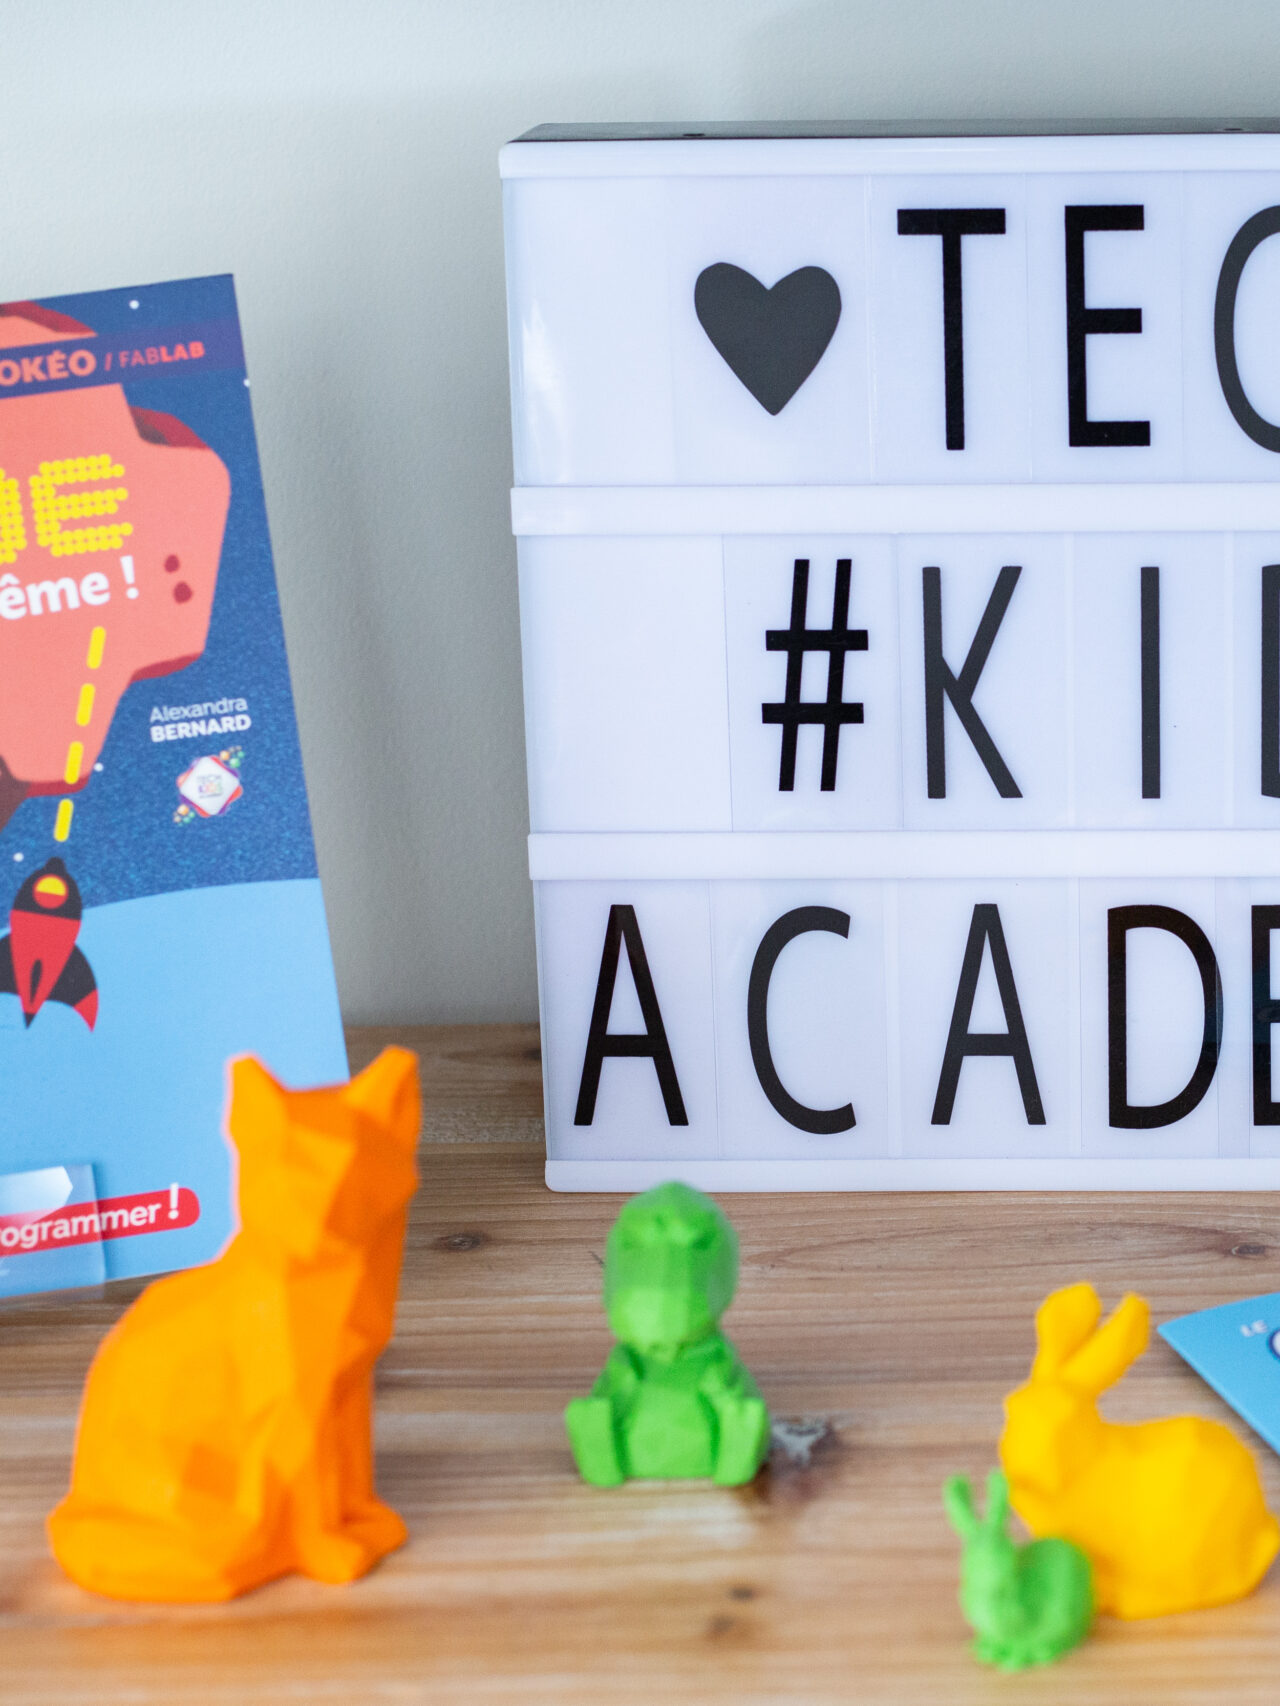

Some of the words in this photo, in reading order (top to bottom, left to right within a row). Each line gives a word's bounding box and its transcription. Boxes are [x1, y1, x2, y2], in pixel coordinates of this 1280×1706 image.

[119, 341, 205, 368] FABLAB
[0, 454, 133, 565] E
[150, 697, 248, 723] Alexandra
[150, 714, 252, 742] BERNARD
